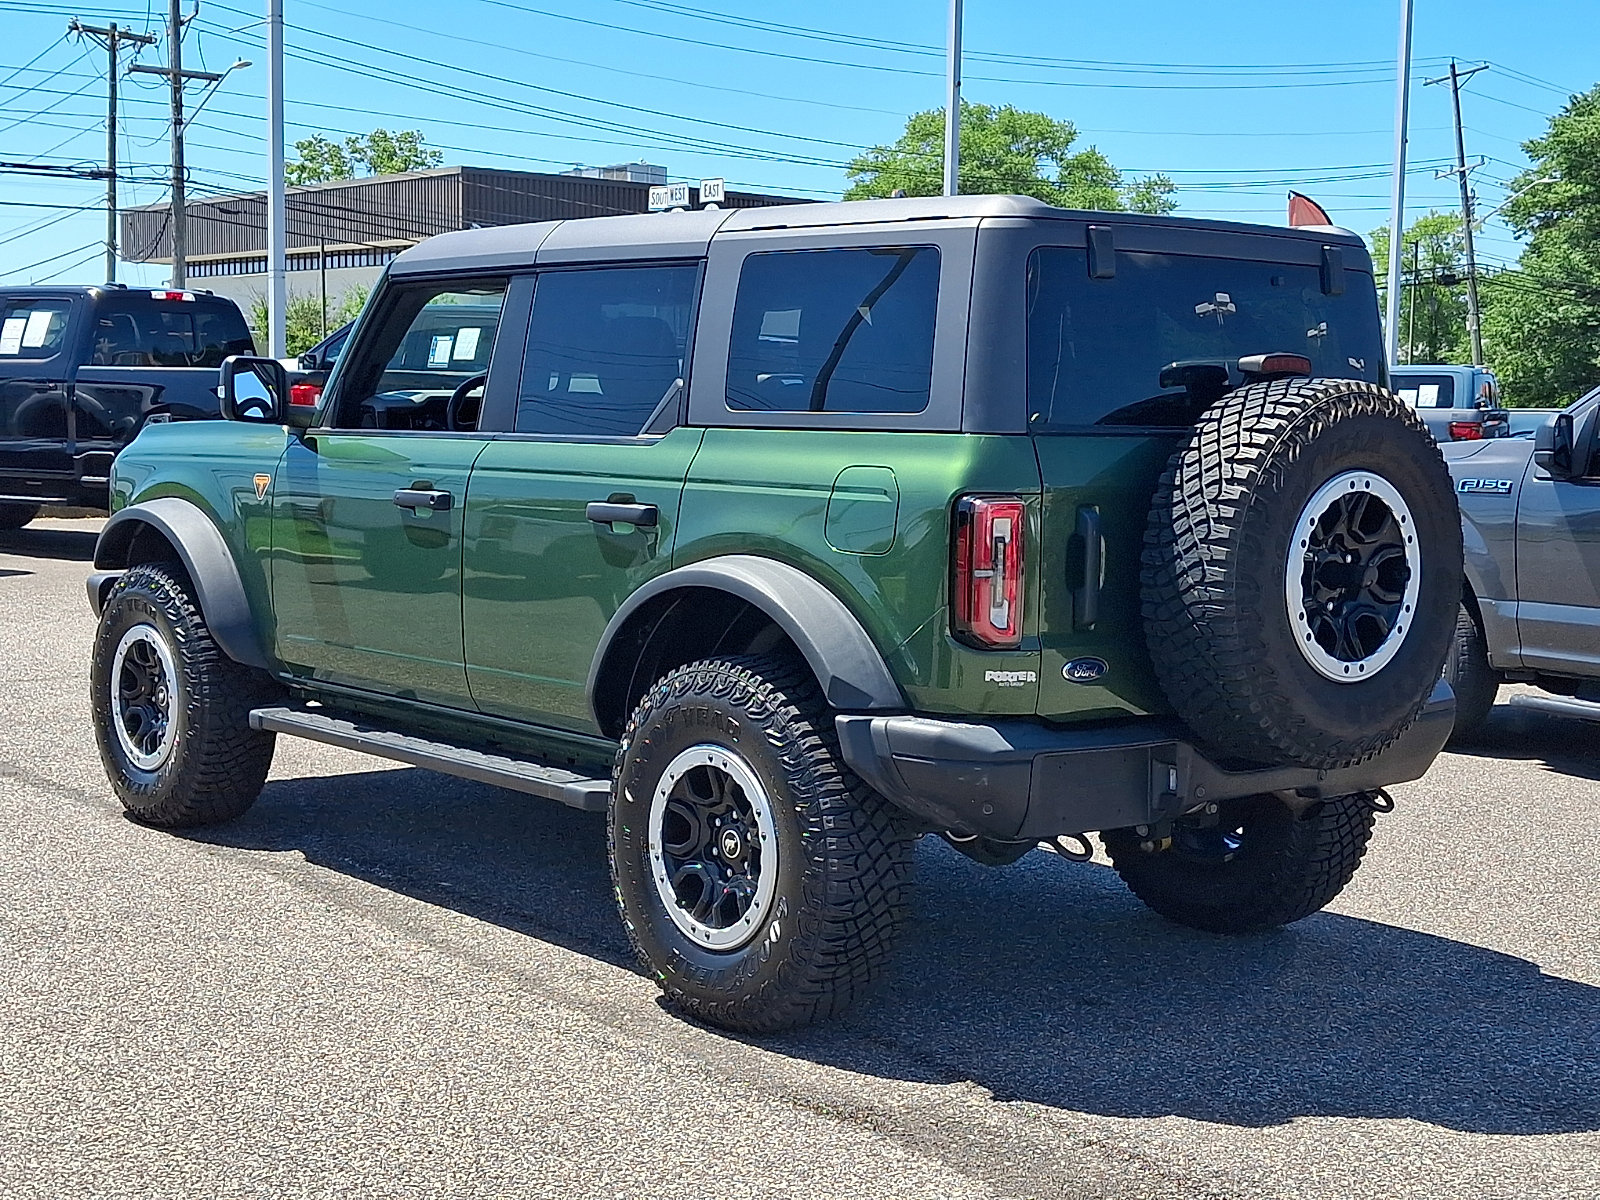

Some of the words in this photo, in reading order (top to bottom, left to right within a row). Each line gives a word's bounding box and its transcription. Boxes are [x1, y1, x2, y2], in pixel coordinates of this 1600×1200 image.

[670, 187, 686, 201] WEST
[704, 183, 720, 198] EAST
[651, 191, 668, 205] SOUT
[985, 670, 1037, 682] PORTER
[1074, 663, 1099, 678] Ford
